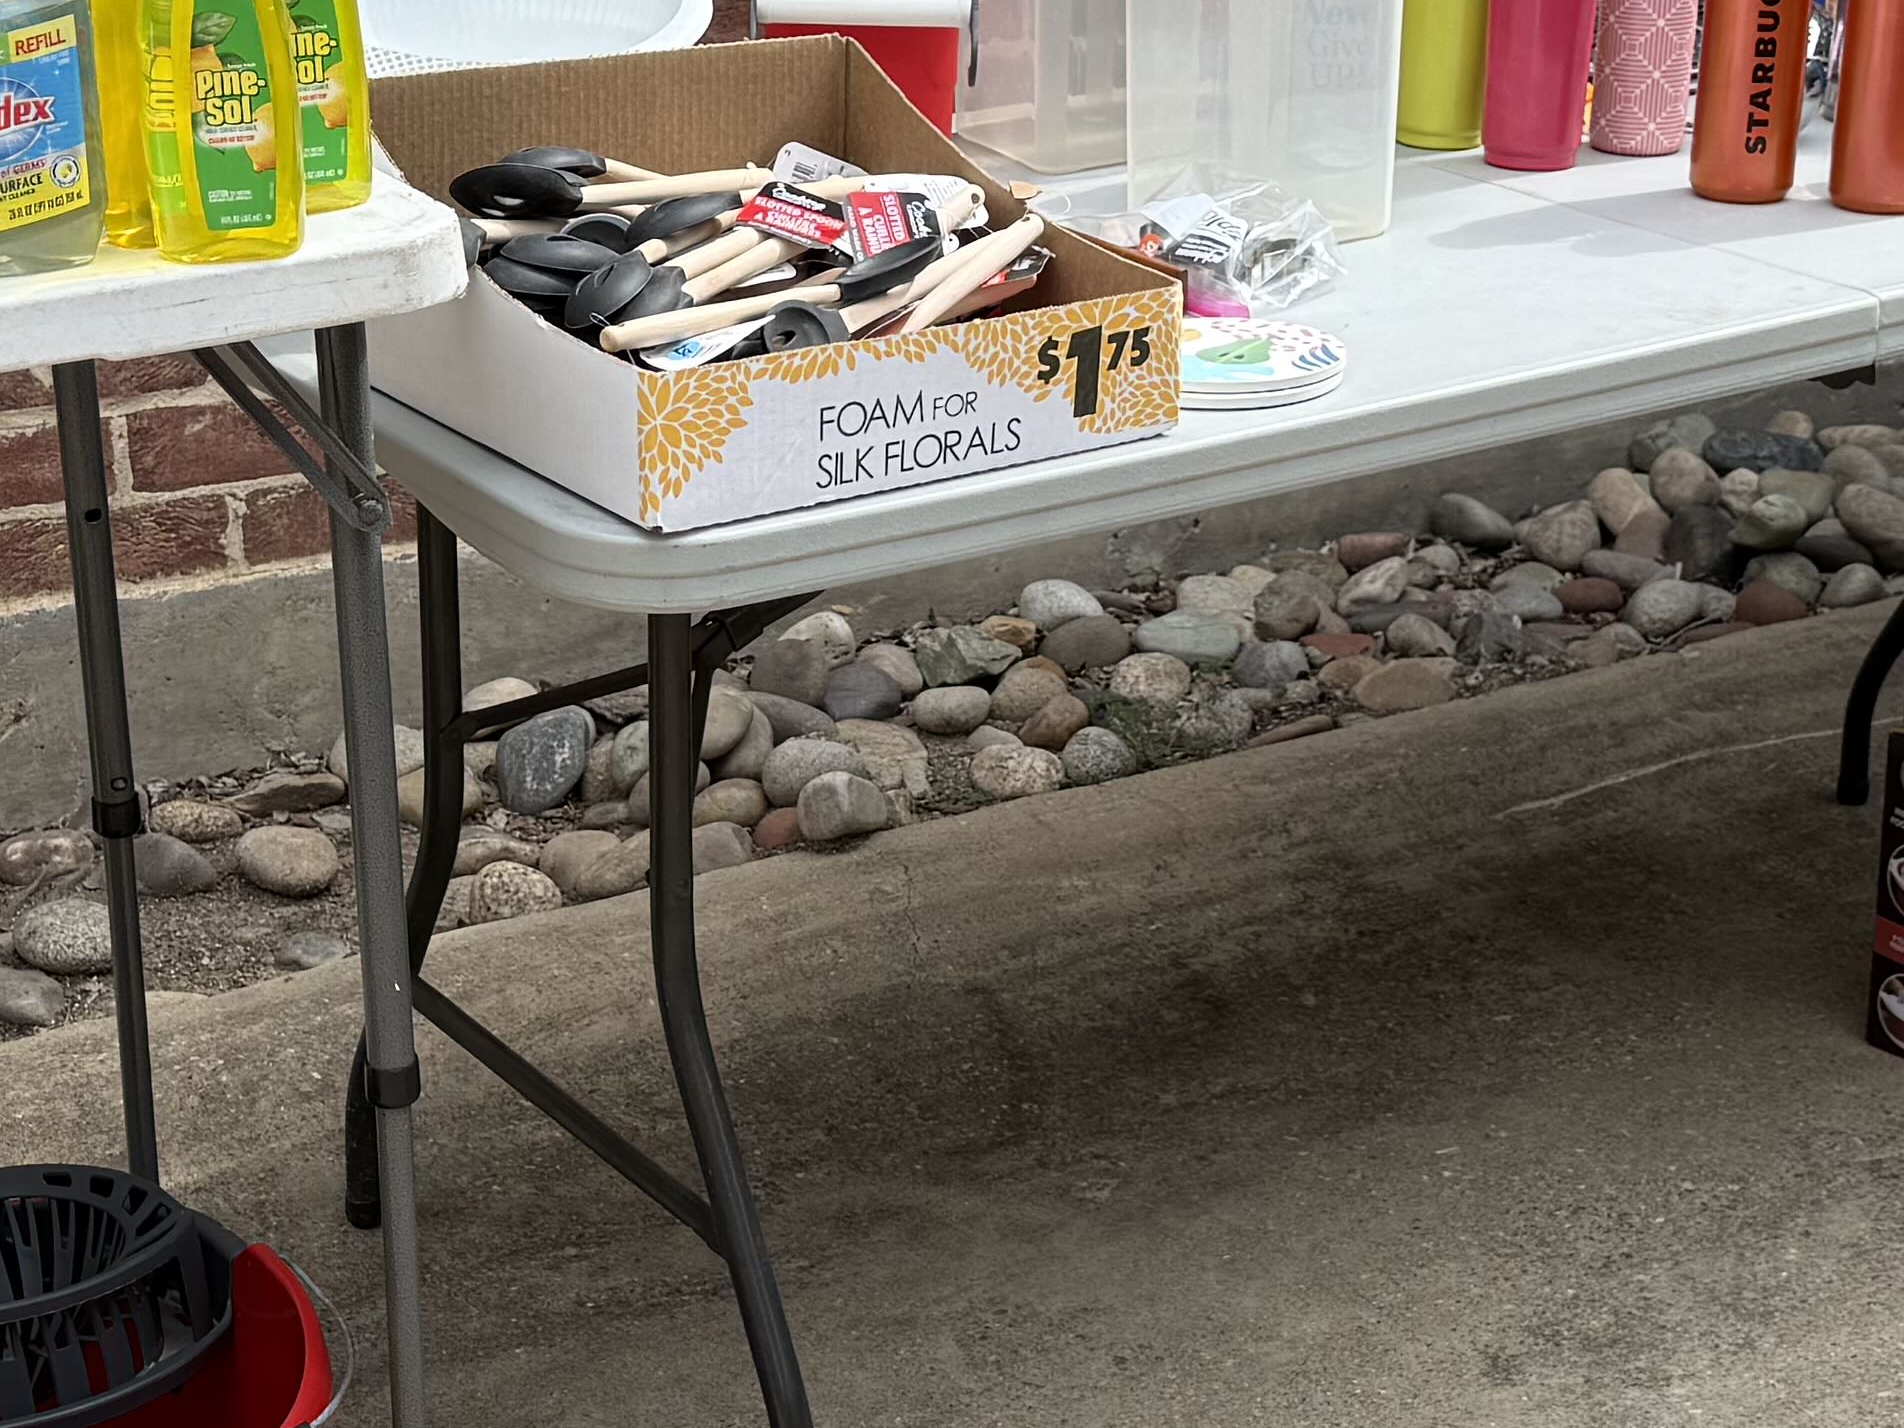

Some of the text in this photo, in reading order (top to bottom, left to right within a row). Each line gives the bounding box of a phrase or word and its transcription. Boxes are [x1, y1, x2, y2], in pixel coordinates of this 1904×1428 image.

[14, 28, 67, 57] REFILL
[195, 69, 267, 100] Pine-
[882, 193, 907, 242] SLOTTED
[819, 389, 980, 443] FOAM FOR
[815, 417, 1022, 489] SILK FLORALS
